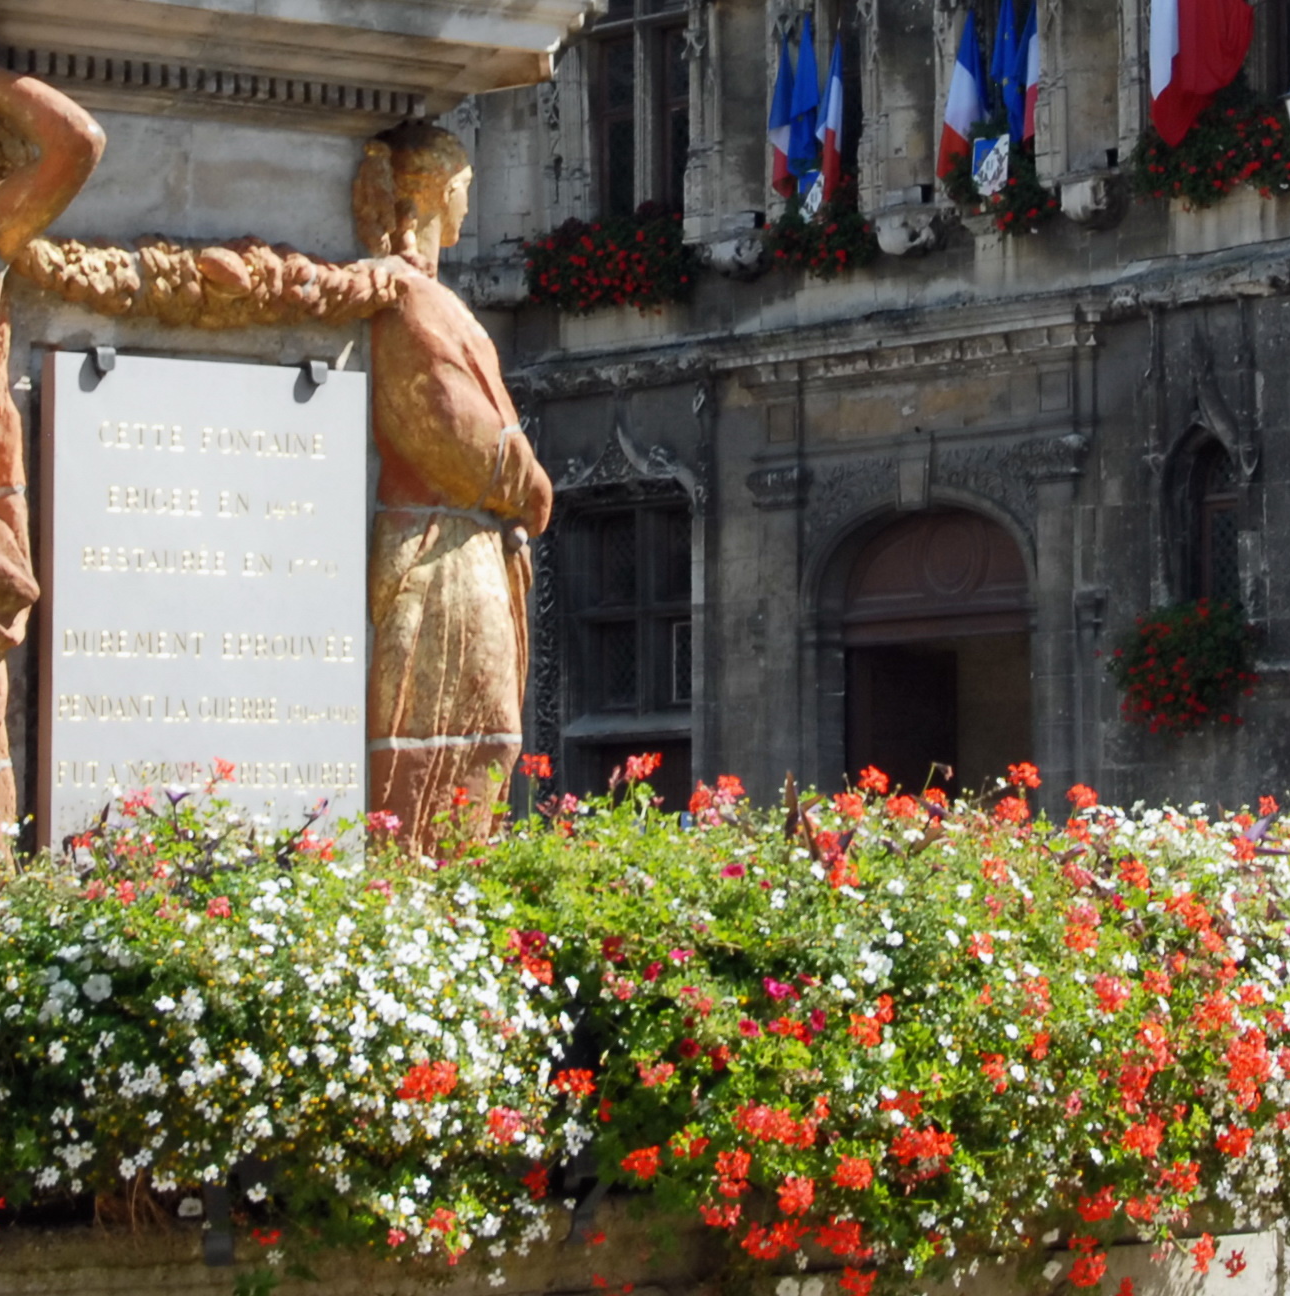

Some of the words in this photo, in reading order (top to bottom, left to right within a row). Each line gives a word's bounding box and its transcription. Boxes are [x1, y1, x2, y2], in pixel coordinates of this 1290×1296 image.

[98, 420, 185, 452] CETTE
[200, 425, 326, 460] FONTAINE
[216, 490, 250, 518] EN
[241, 552, 273, 577] EN
[61, 628, 206, 659] DUREMENT
[56, 693, 156, 722] PENDANT
[163, 695, 191, 723] LA
[198, 695, 279, 724] GUERRE
[55, 760, 99, 788] FUT
[125, 760, 229, 789] NOUVEA
